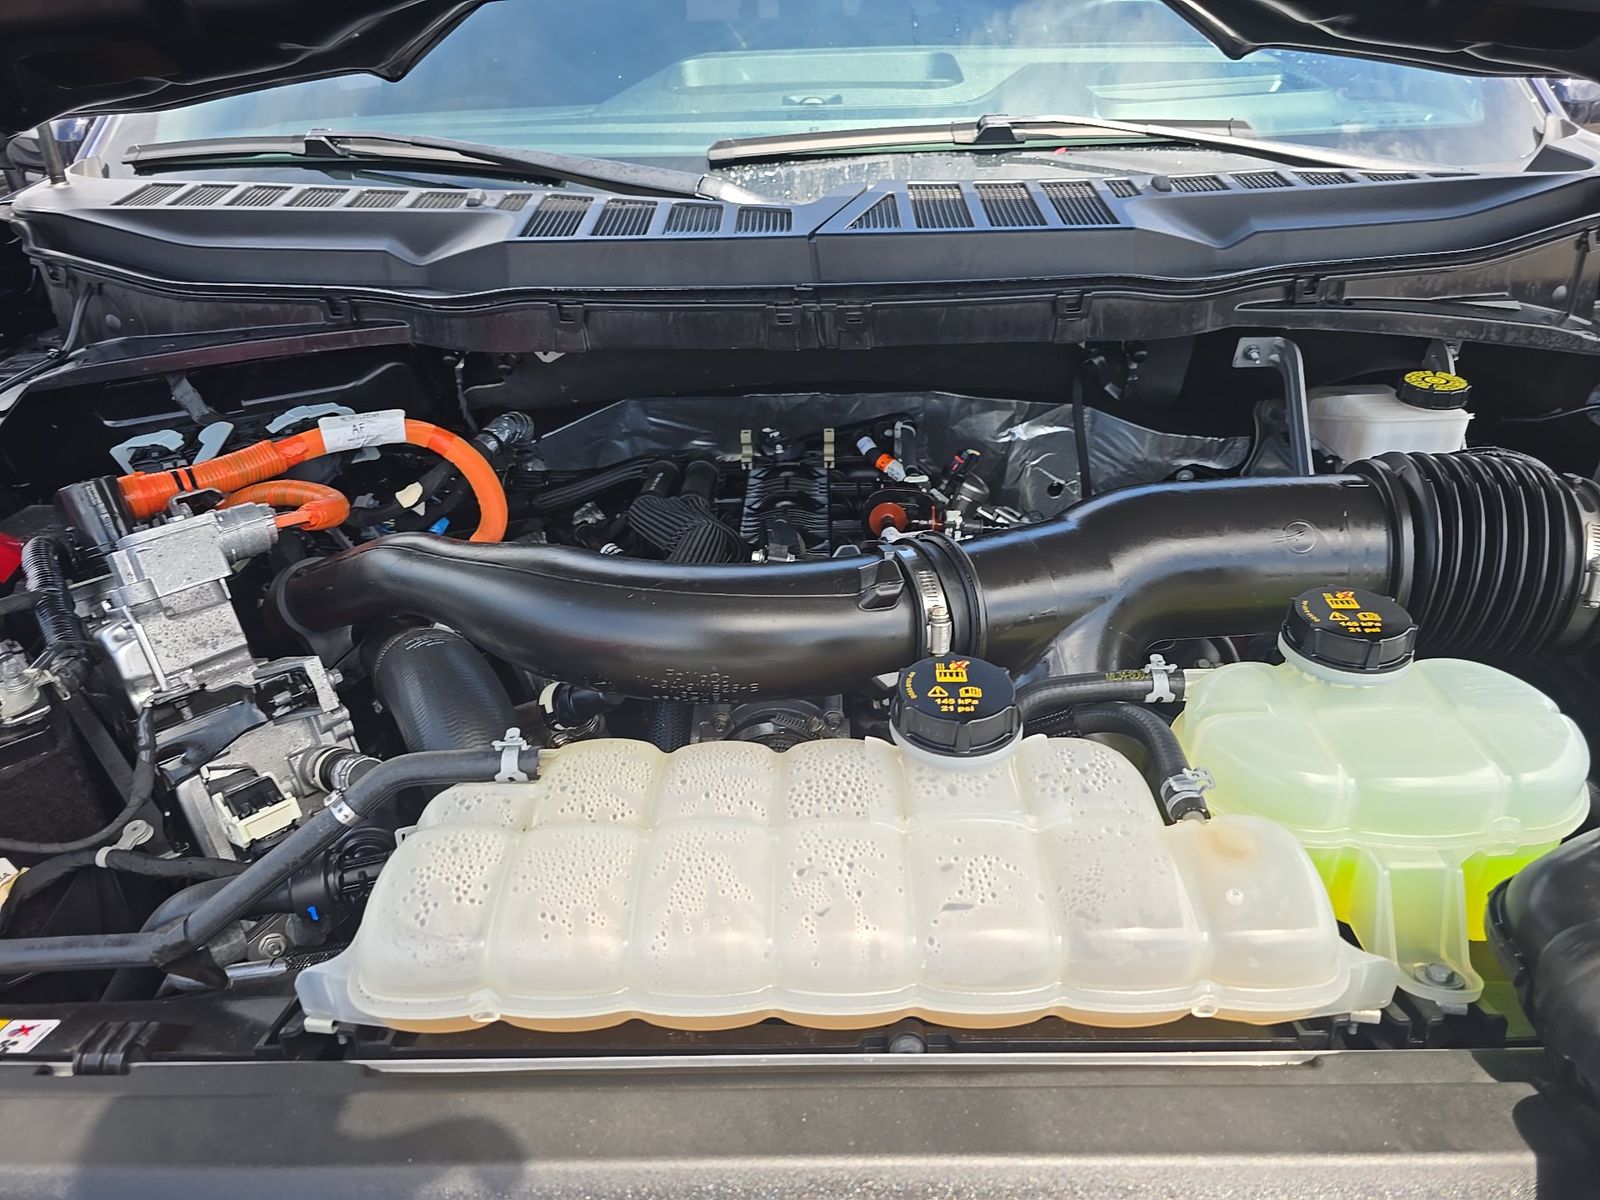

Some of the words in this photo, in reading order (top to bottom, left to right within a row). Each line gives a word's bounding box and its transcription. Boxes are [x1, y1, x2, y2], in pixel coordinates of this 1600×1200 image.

[353, 422, 366, 434] AF
[934, 697, 956, 705] 145
[957, 697, 979, 705] kPa
[957, 705, 975, 713] psi
